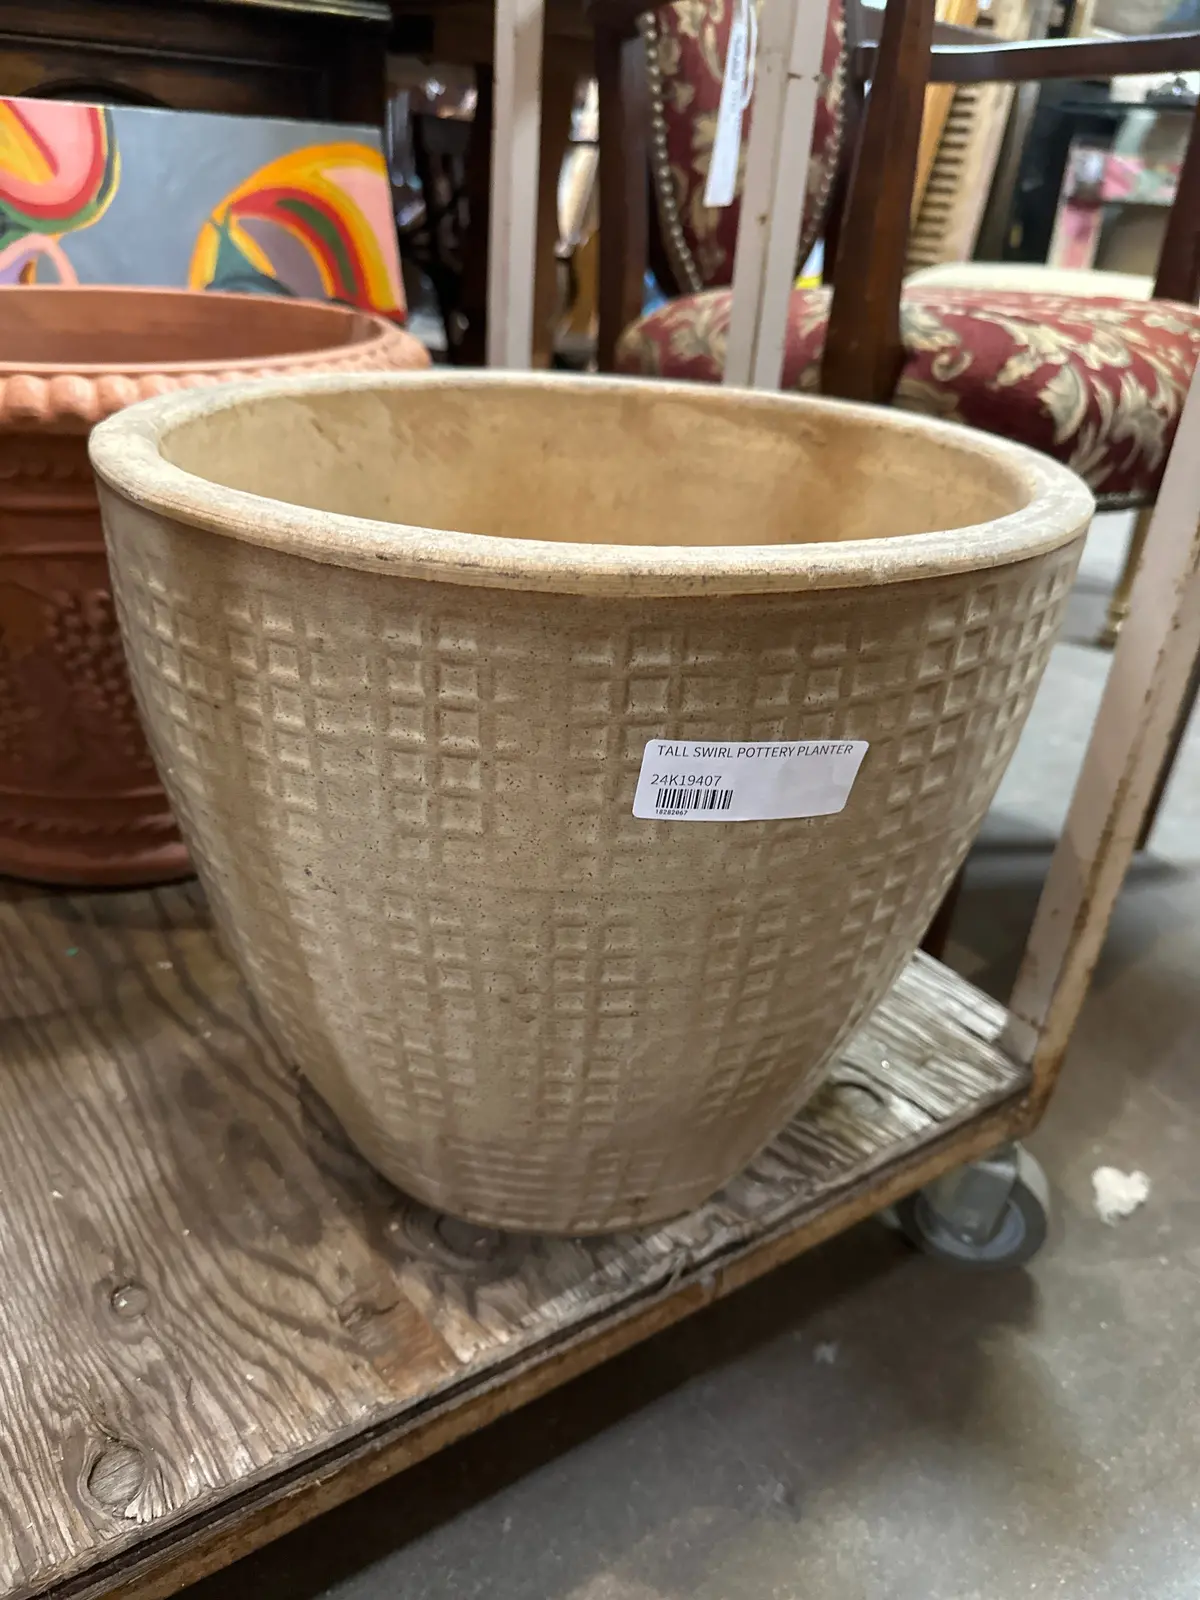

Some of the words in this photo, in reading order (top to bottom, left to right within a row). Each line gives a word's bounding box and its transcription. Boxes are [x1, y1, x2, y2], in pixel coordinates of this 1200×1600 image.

[657, 745, 690, 758] TALL
[693, 746, 733, 758] SWIRL
[736, 746, 796, 758] POTTERY
[797, 744, 853, 757] PLANTER
[650, 773, 722, 787] 24K19407
